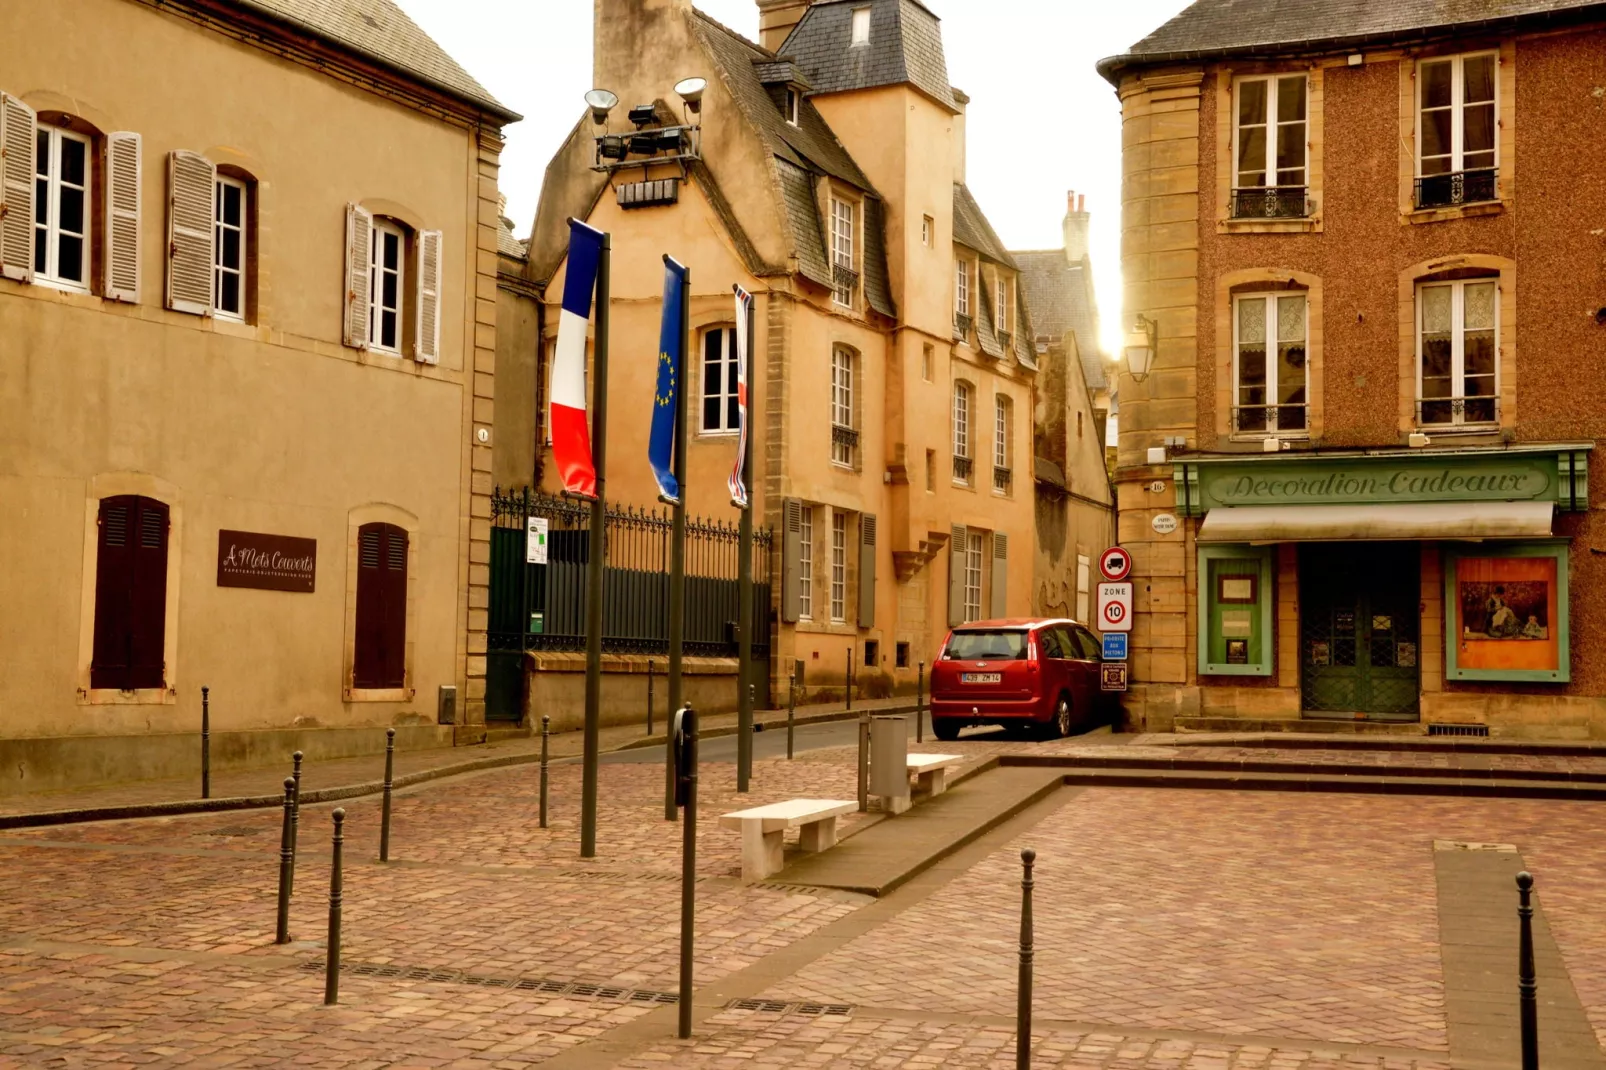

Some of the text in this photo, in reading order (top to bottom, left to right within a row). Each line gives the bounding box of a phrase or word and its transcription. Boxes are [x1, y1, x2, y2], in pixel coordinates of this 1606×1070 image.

[272, 551, 313, 571] Couverts
[1104, 588, 1126, 596] ZONE
[1108, 606, 1121, 617] 10
